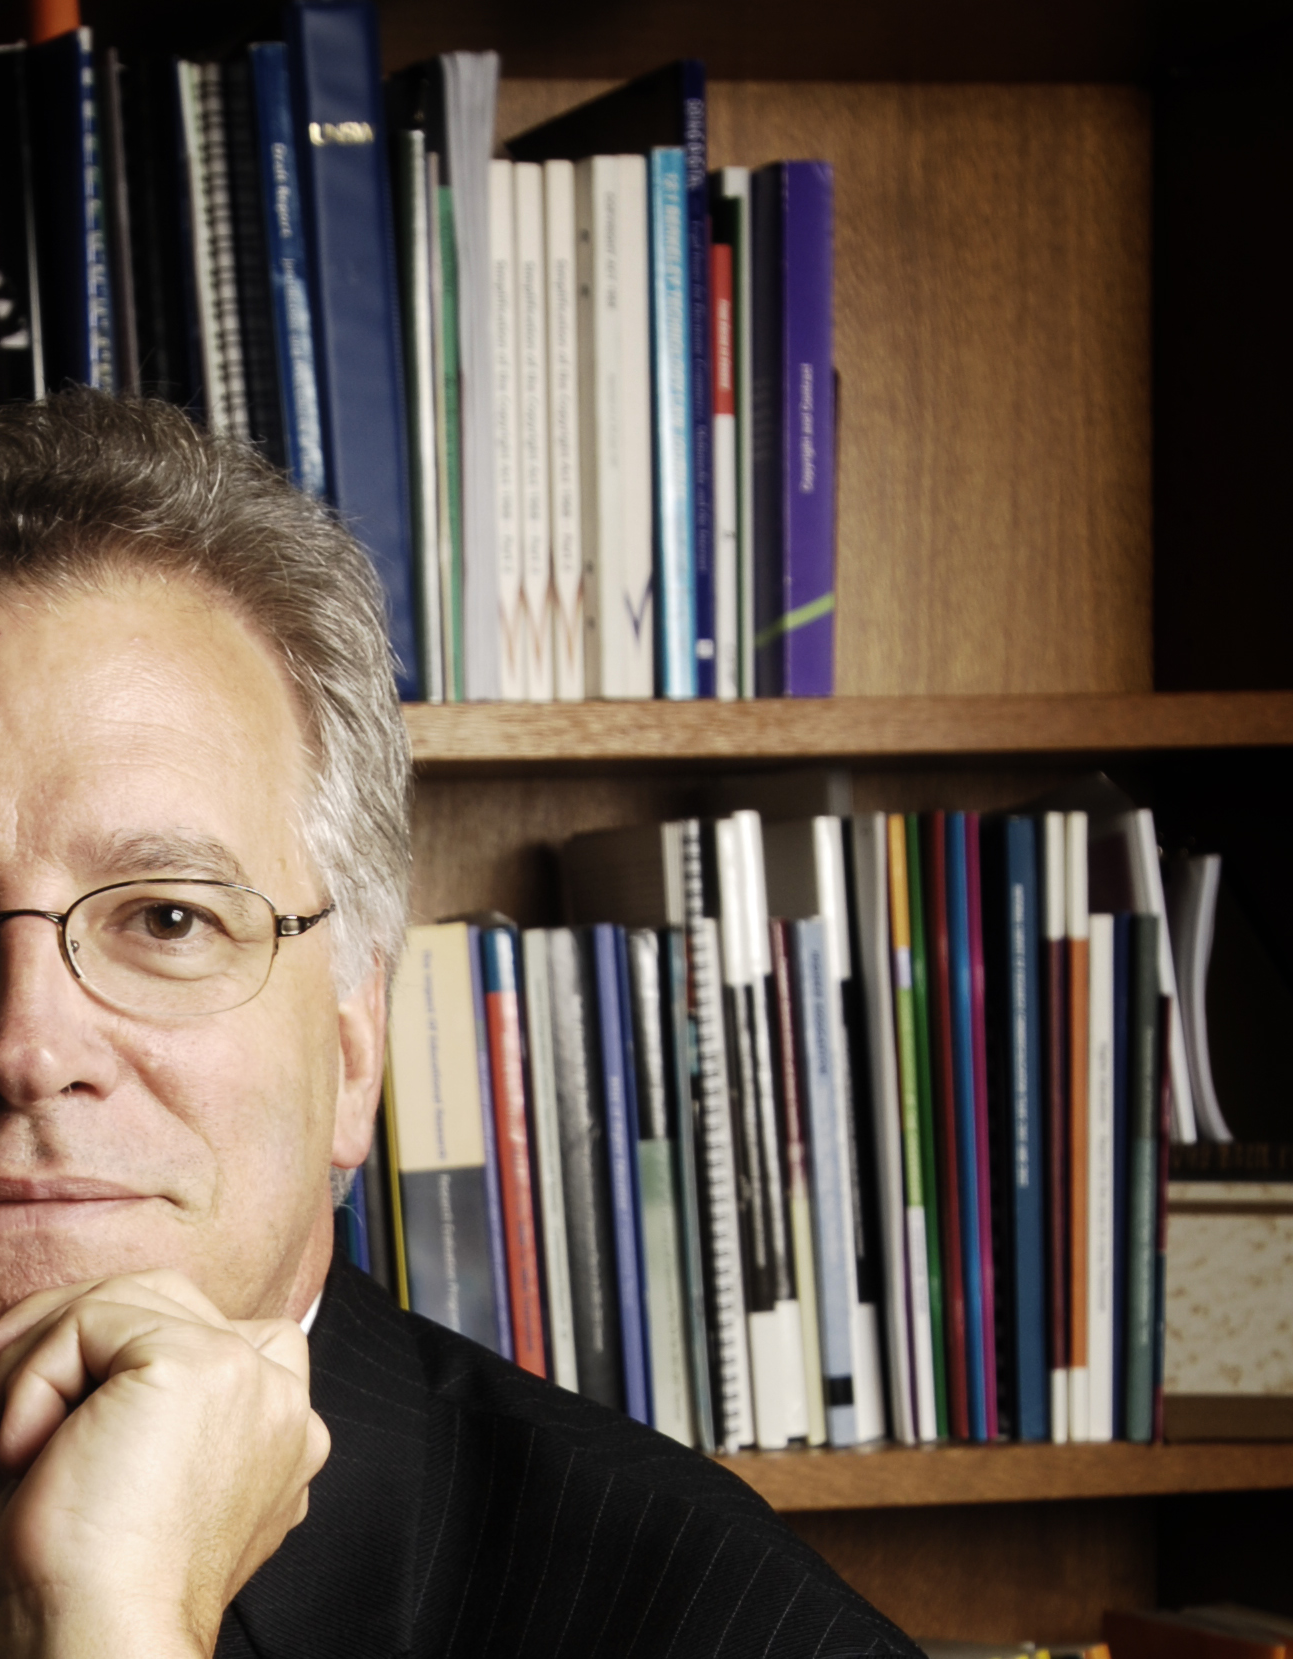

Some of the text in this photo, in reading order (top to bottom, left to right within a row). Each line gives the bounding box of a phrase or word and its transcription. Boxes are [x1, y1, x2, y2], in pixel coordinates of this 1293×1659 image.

[685, 99, 705, 141] GOING
[271, 143, 294, 238] Draft Report
[495, 260, 511, 348] Simplification
[523, 261, 539, 349] Simplification
[553, 258, 570, 347] Simplification
[498, 351, 512, 366] of
[498, 370, 512, 392] the
[527, 353, 540, 367] of
[558, 350, 572, 364] of
[558, 368, 571, 390] the
[527, 372, 540, 393] the
[497, 395, 513, 459] Copyright
[526, 395, 542, 461] Copyright
[558, 393, 573, 458] Copyright
[798, 412, 814, 435] and
[501, 462, 513, 485] Act
[530, 464, 541, 486] Act
[562, 460, 573, 483] Act
[797, 436, 816, 496] Copyright
[815, 1002, 828, 1074] EDUCATION
[429, 1035, 442, 1103] Educational
[433, 1107, 447, 1160] Research
[438, 1174, 453, 1221] Research
[440, 1223, 457, 1281] Evaluation
